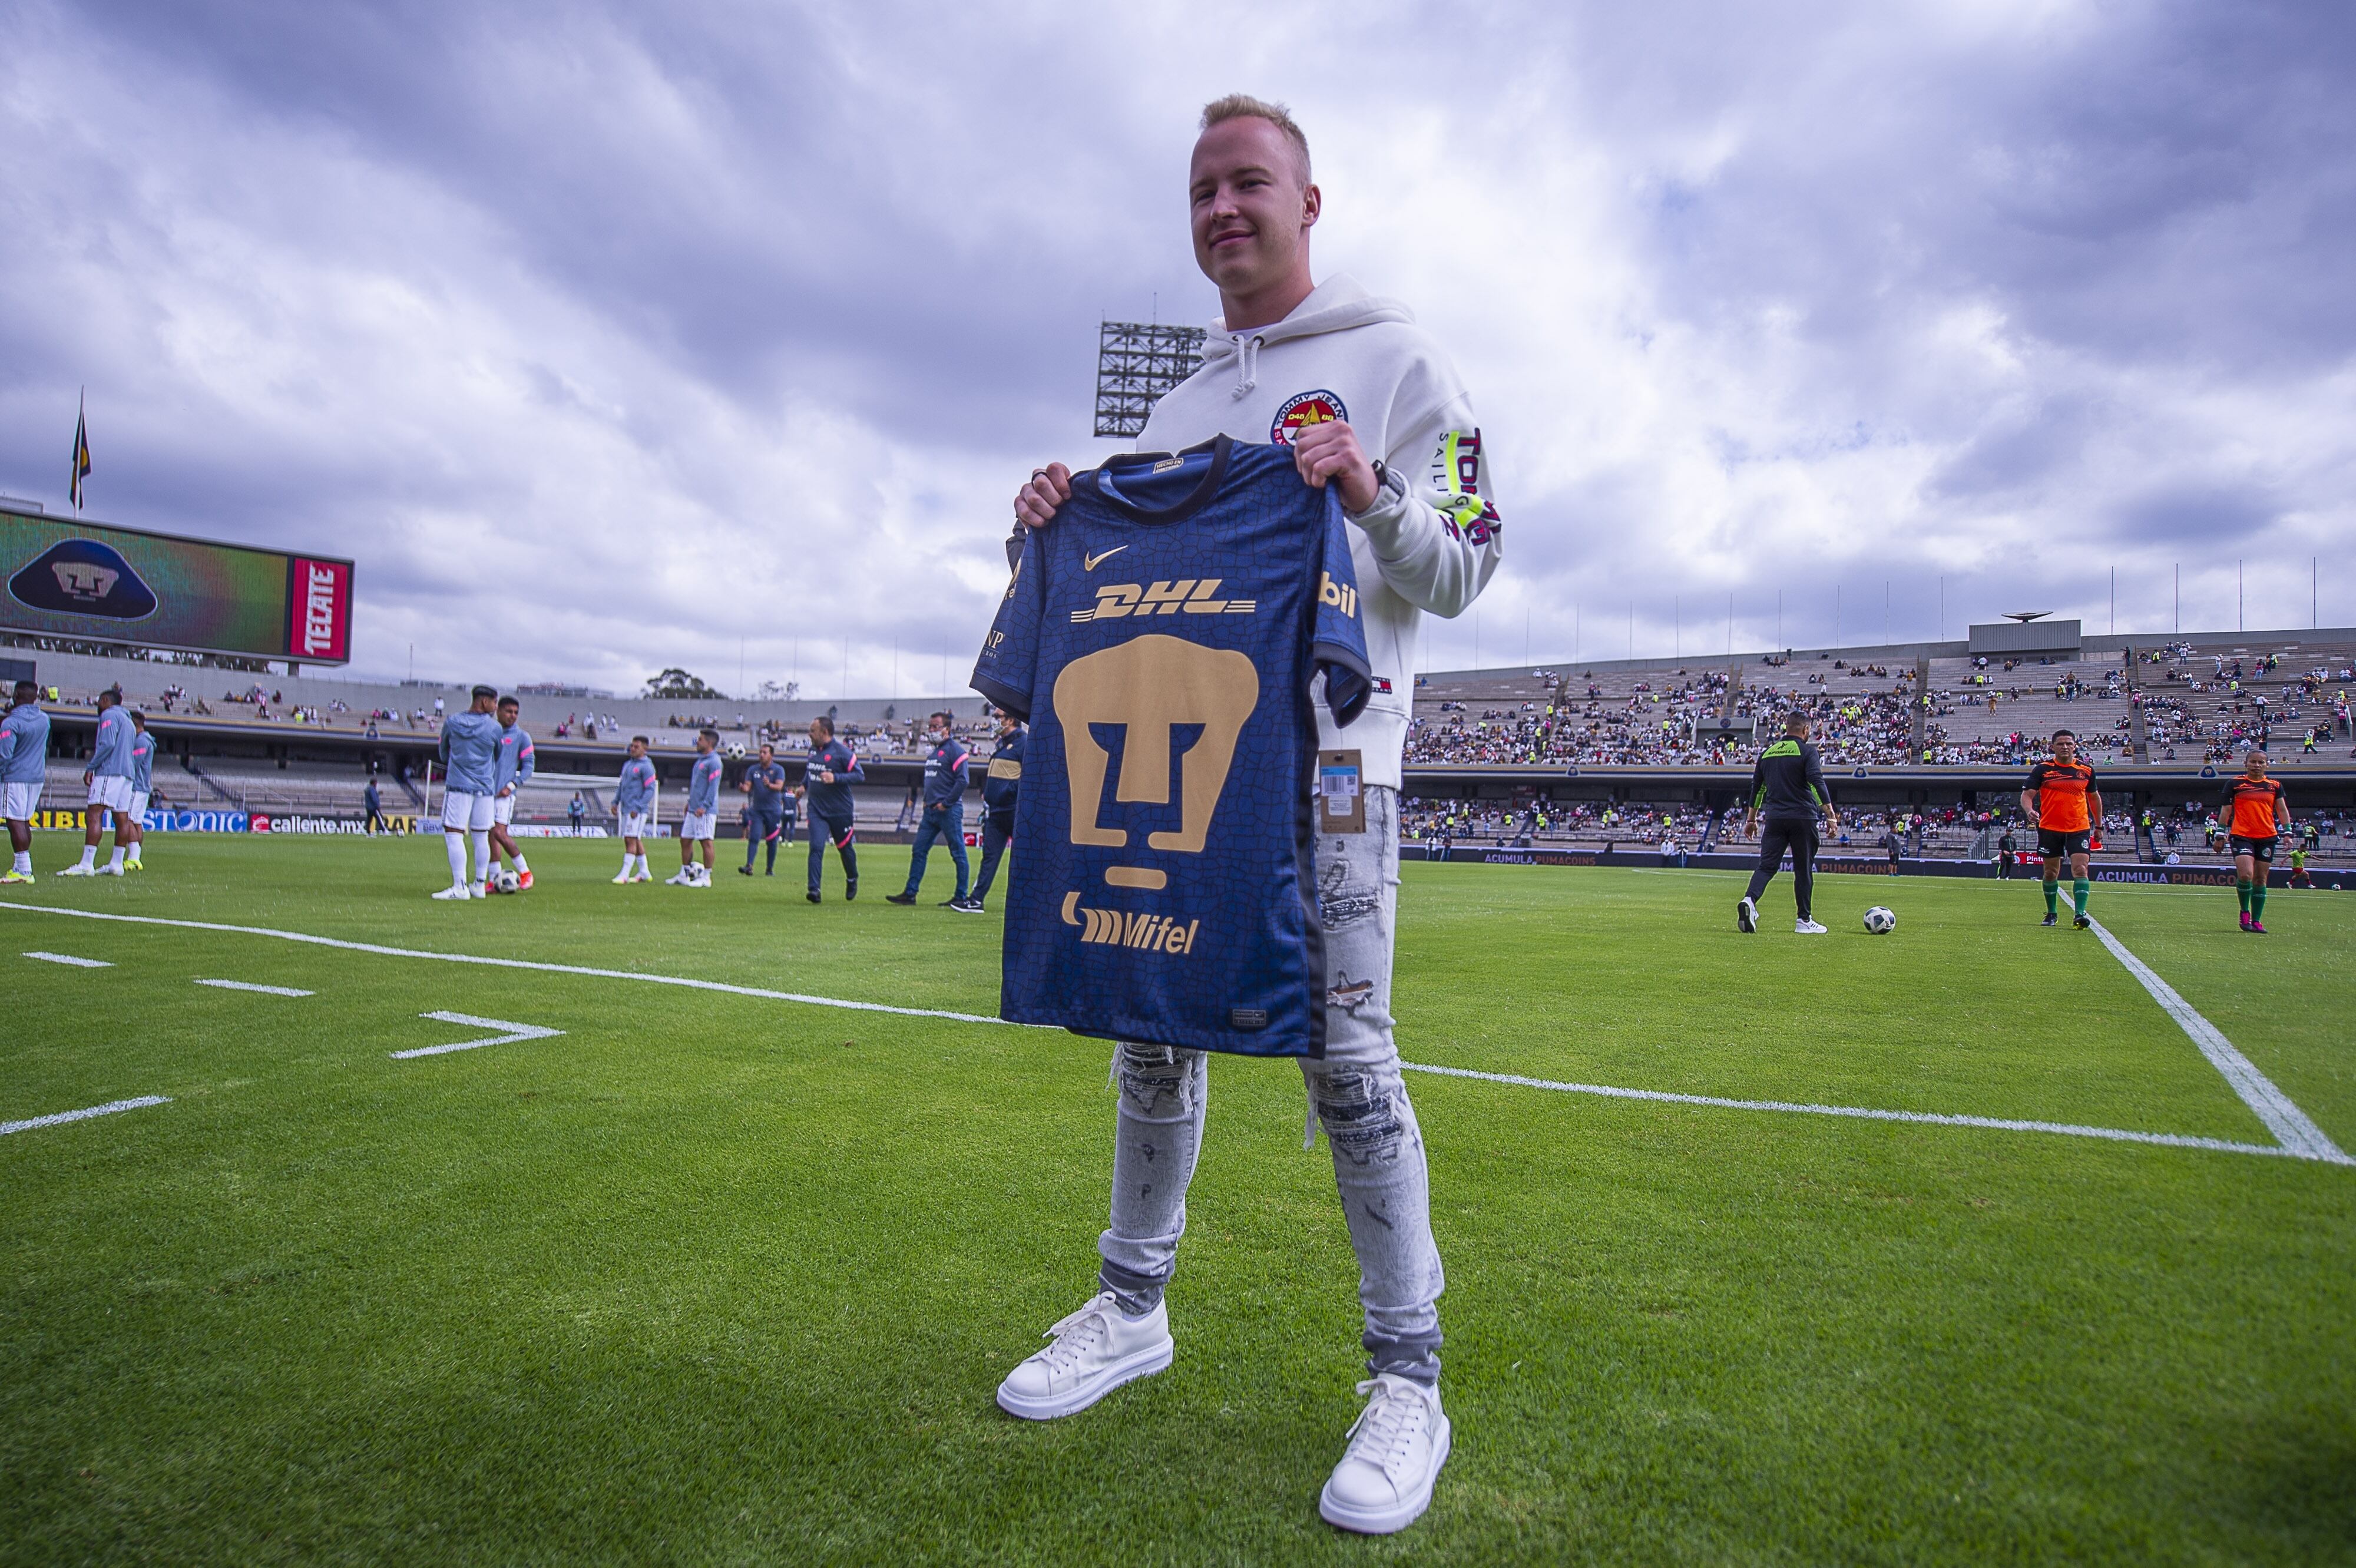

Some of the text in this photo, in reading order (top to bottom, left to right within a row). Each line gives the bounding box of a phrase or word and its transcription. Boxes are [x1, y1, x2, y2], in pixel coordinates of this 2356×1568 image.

[1276, 394, 1343, 425] TOMMY JEAN
[1432, 432, 1469, 505] SAILIG
[305, 561, 334, 655] TECATE
[1093, 579, 1228, 619] DHL
[271, 816, 365, 834] caliente.mx
[1485, 854, 1596, 865] ACUMULA PUMACOINS
[2096, 871, 2168, 883] ACUMULA
[1123, 913, 1199, 954] Mifel
